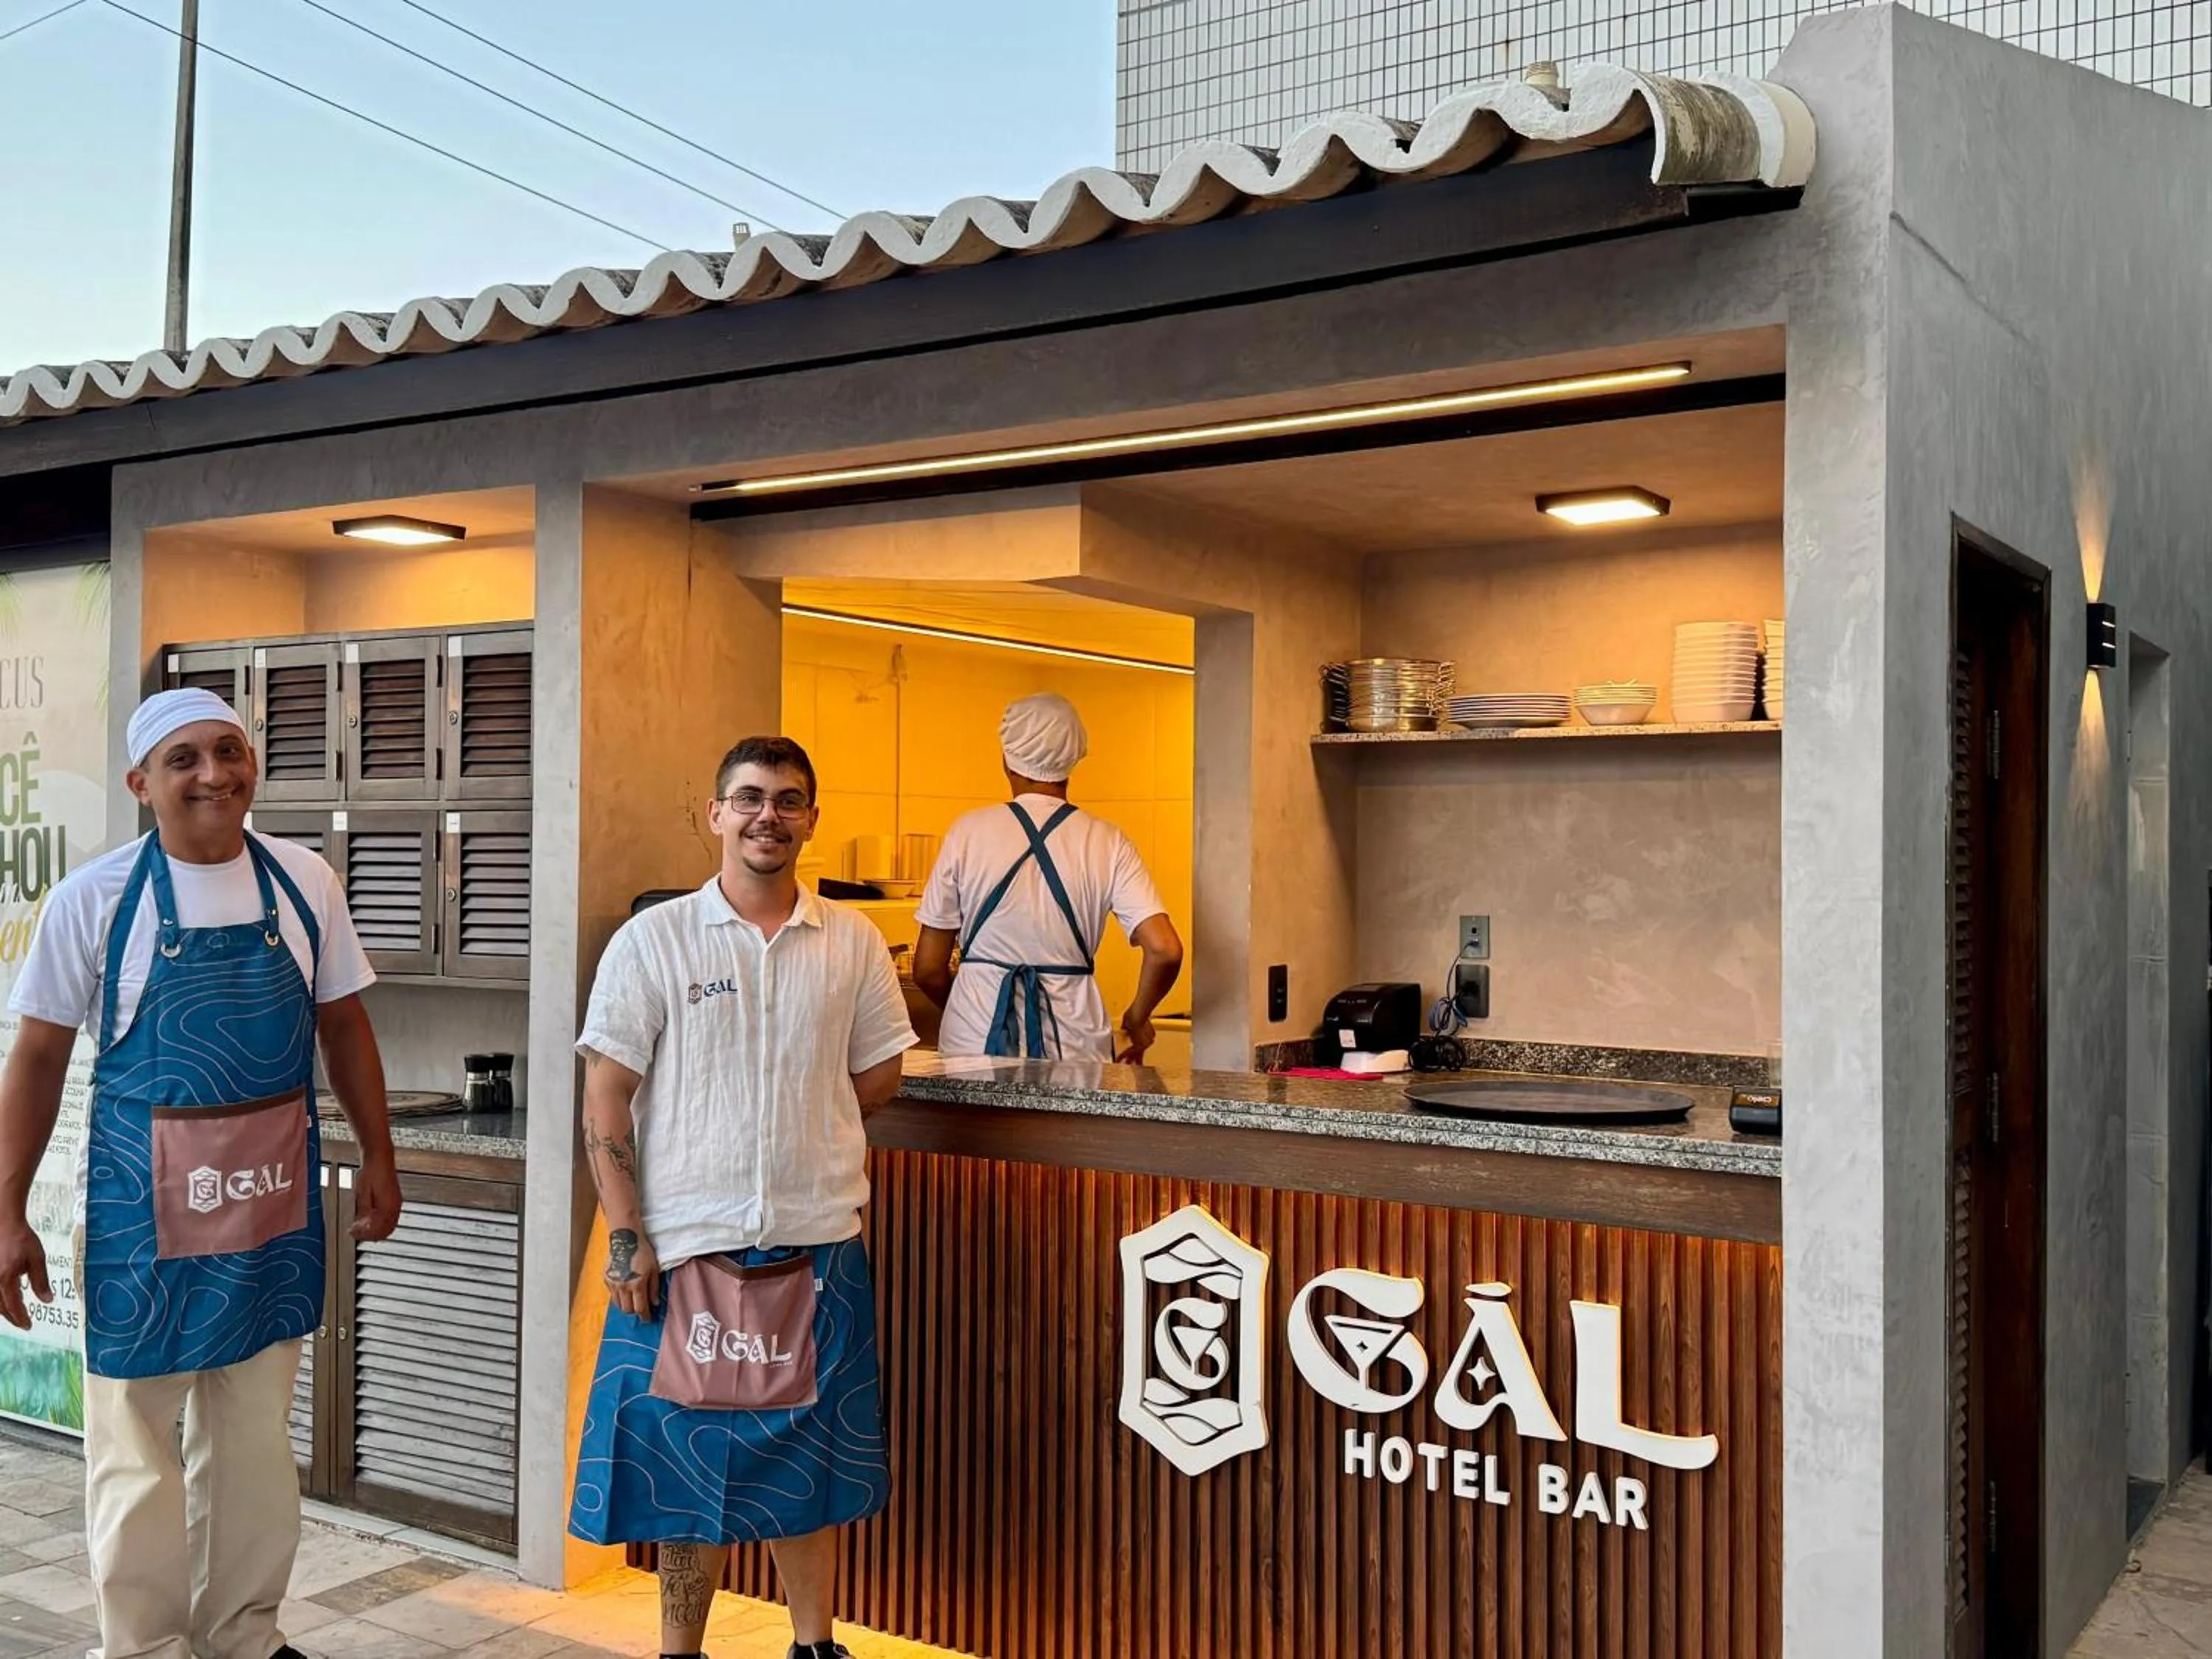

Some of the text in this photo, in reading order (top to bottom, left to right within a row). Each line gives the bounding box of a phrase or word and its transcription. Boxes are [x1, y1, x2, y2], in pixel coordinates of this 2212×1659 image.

[0, 731, 41, 827] CÊ
[703, 978, 738, 998] GAL
[226, 1162, 293, 1200] GAL
[721, 1329, 792, 1364] GAL
[1287, 1267, 1719, 1470] GAL
[1343, 1427, 1649, 1531] HOTEL BAR
